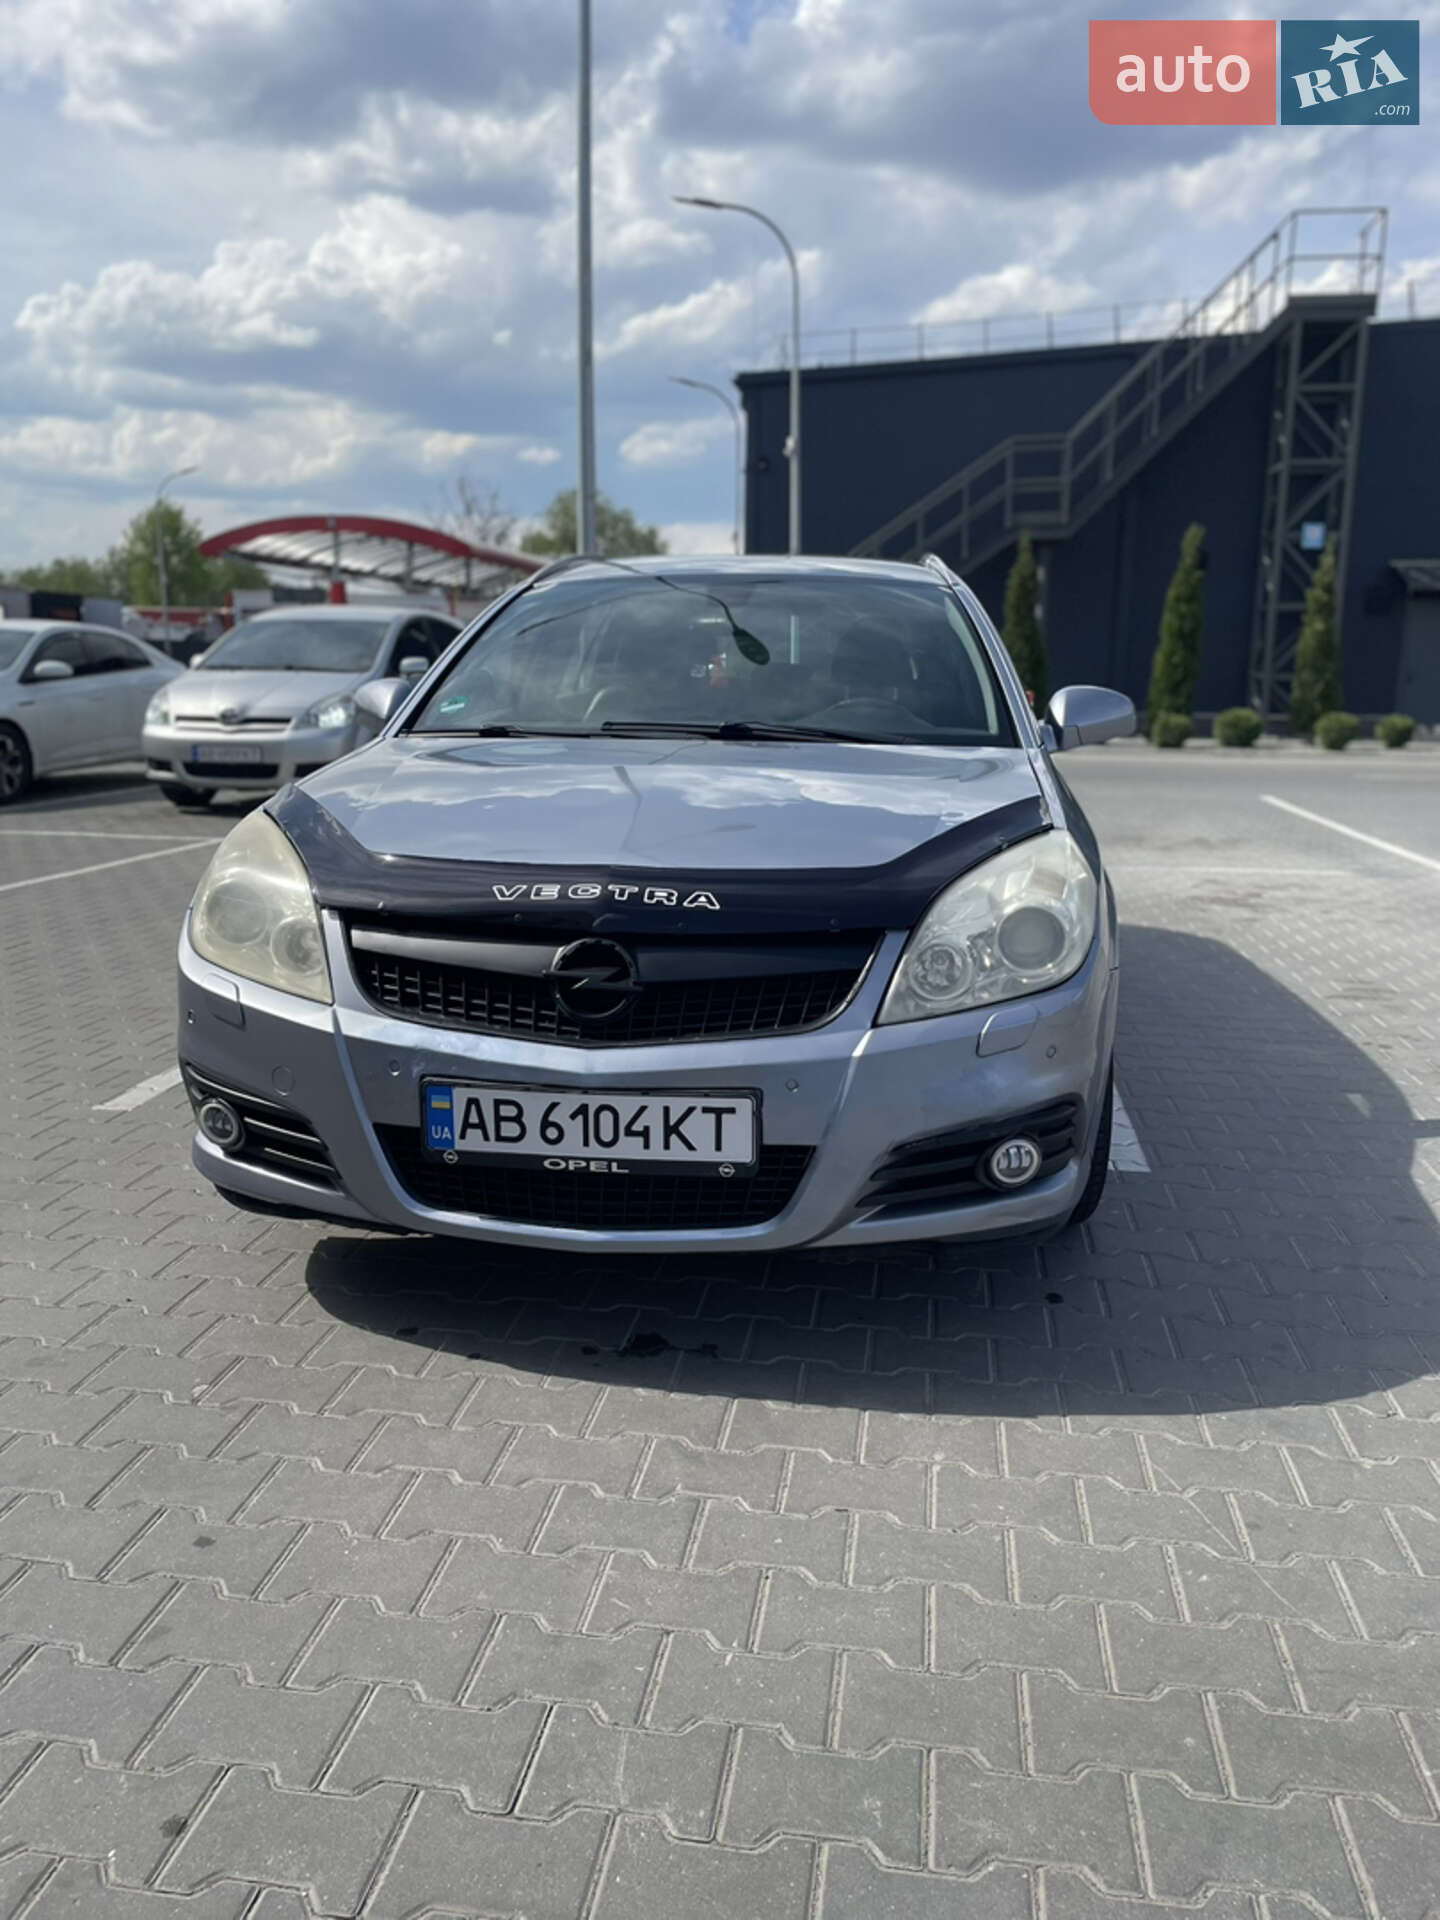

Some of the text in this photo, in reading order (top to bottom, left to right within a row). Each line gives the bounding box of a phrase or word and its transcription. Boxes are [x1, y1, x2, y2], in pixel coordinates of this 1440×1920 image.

[492, 883, 721, 910] VECTRA
[432, 1125, 452, 1141] UA
[543, 1157, 630, 1174] OPEL
